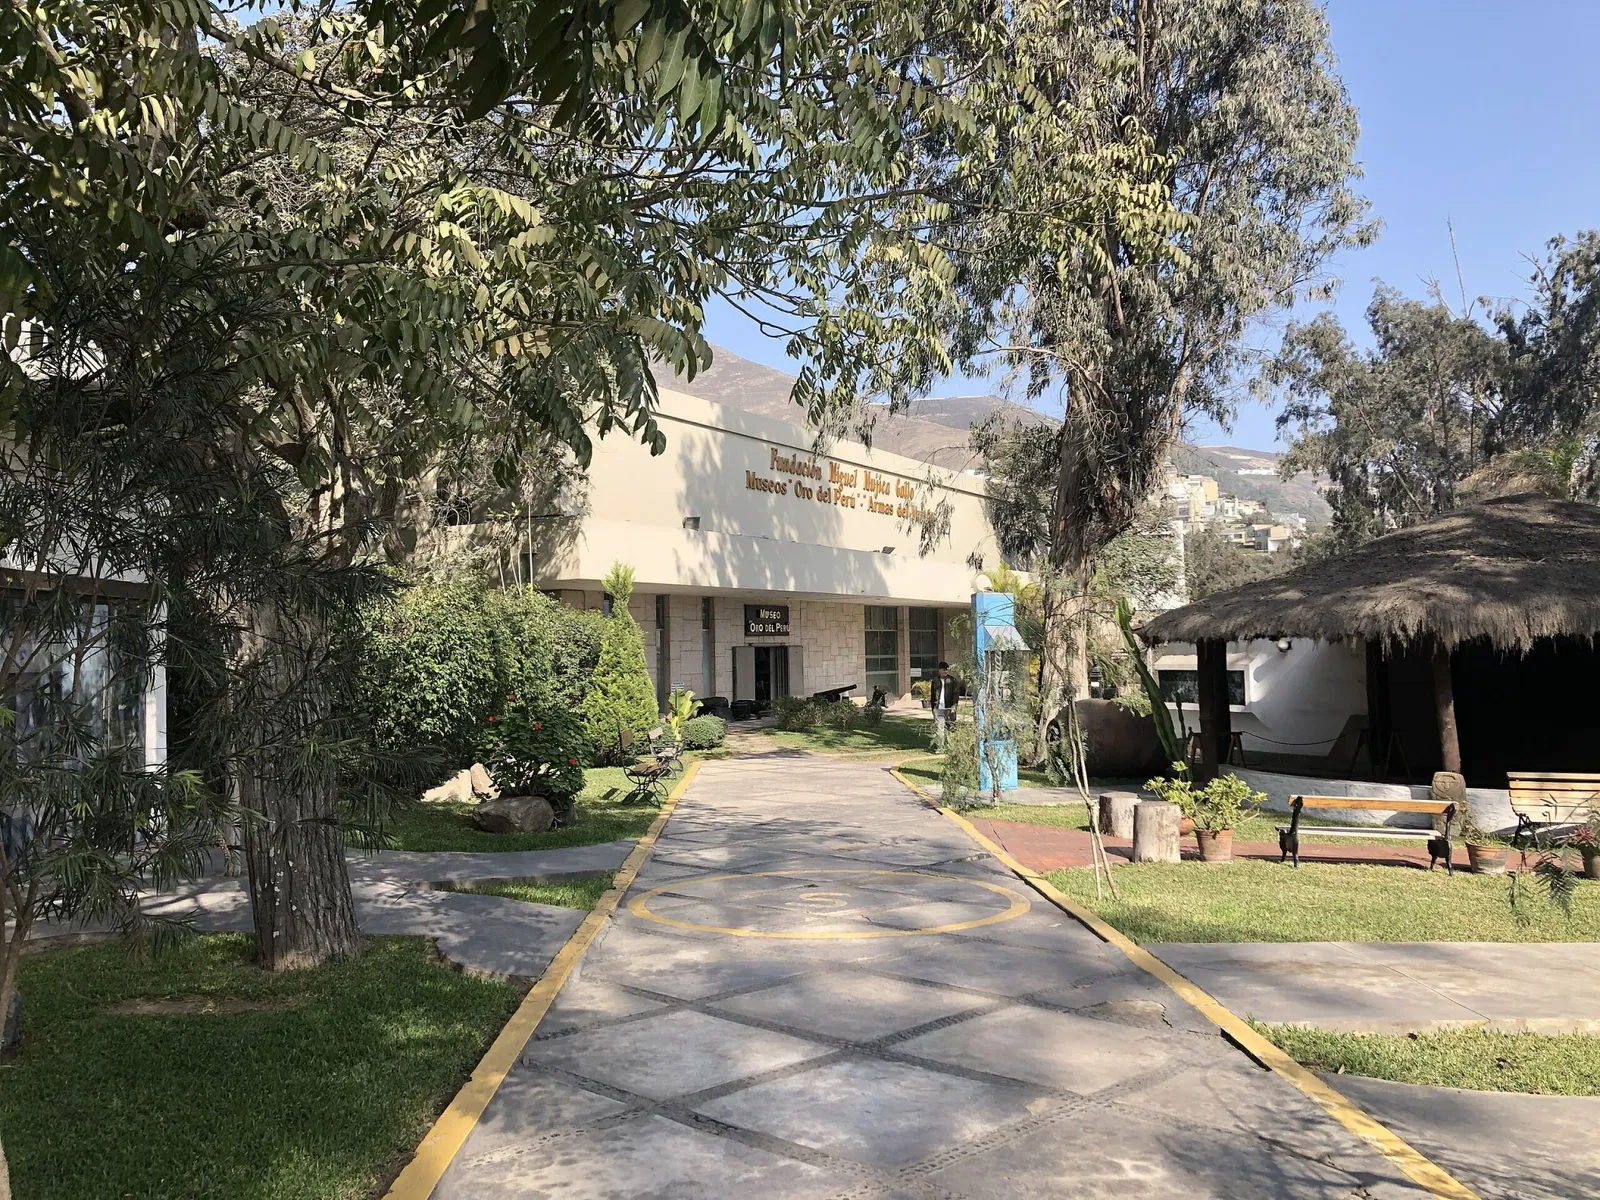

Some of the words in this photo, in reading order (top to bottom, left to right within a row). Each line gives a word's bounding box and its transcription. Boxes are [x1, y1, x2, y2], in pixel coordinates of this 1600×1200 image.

[745, 470, 787, 495] Museos
[816, 486, 831, 504] del
[828, 461, 858, 491] Miguel
[863, 470, 890, 499] Mujica
[760, 609, 781, 619] MUSEO
[765, 624, 775, 632] DEL
